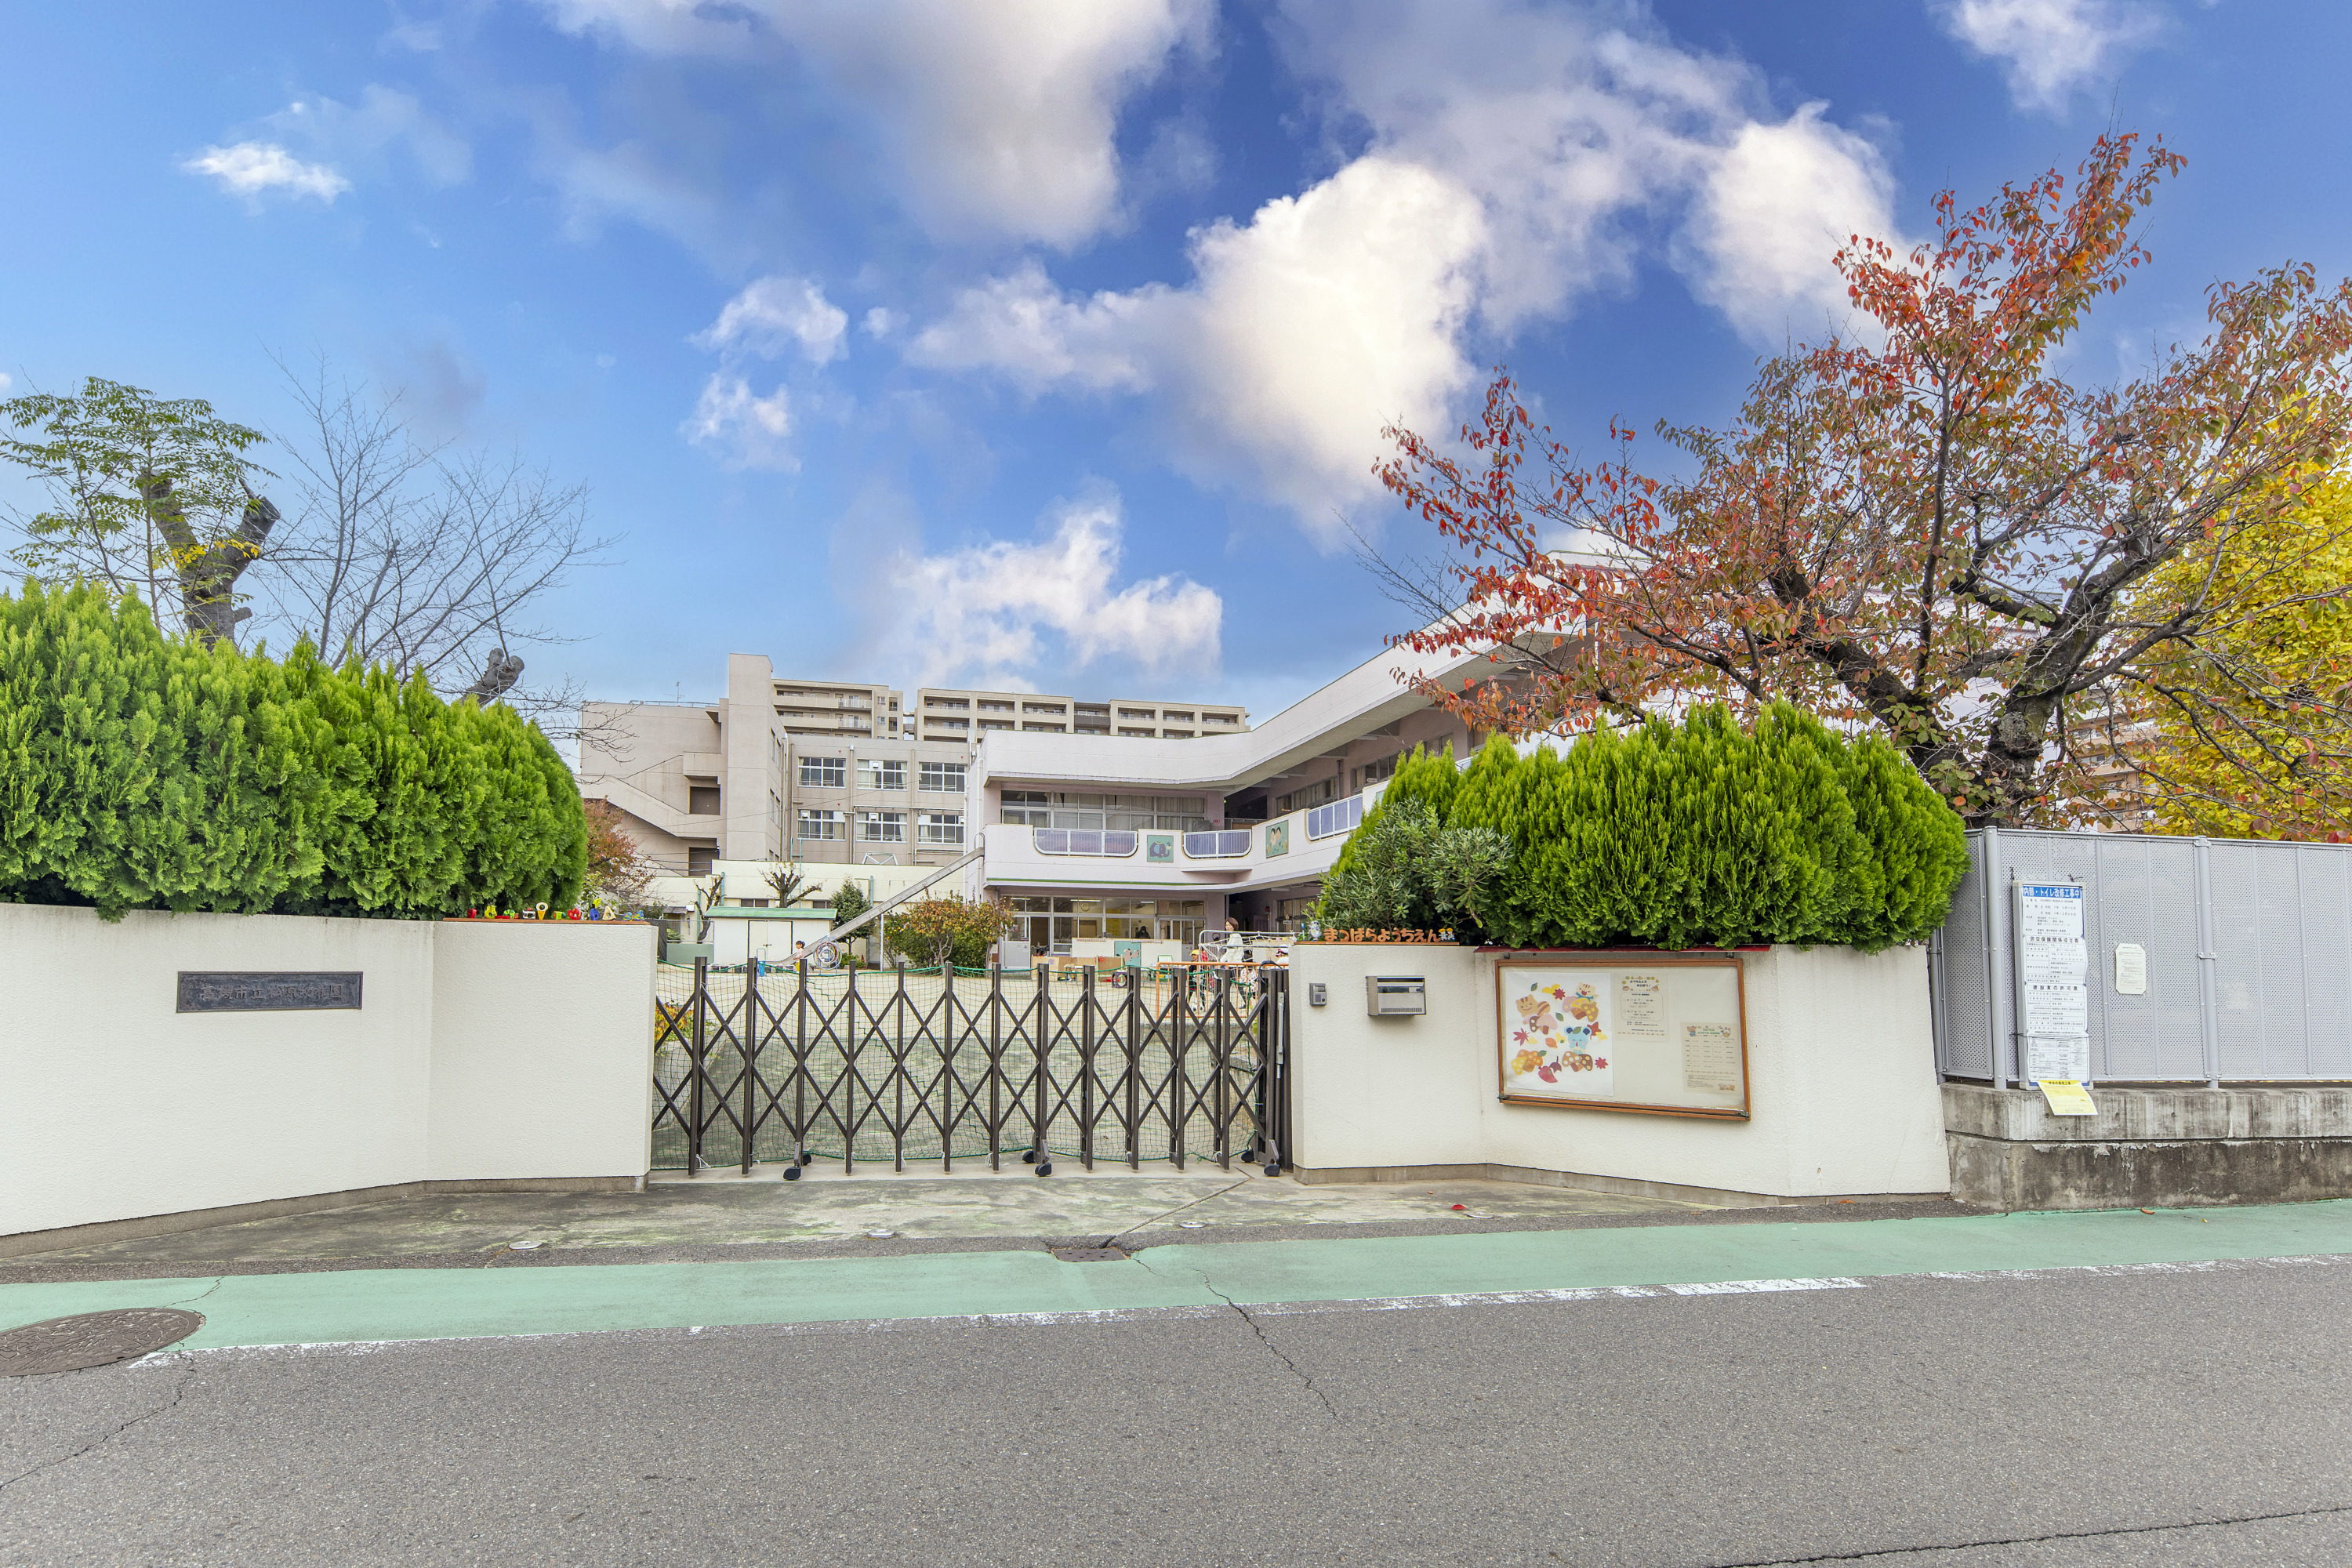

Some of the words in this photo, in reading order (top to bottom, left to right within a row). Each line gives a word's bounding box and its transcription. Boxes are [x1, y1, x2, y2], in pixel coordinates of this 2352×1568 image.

[2024, 887, 2080, 898] 内部・トイレ改修工事中
[1323, 927, 1441, 942] まつばらようちえん
[199, 983, 345, 1000] 高槻市立松原幼稚園
